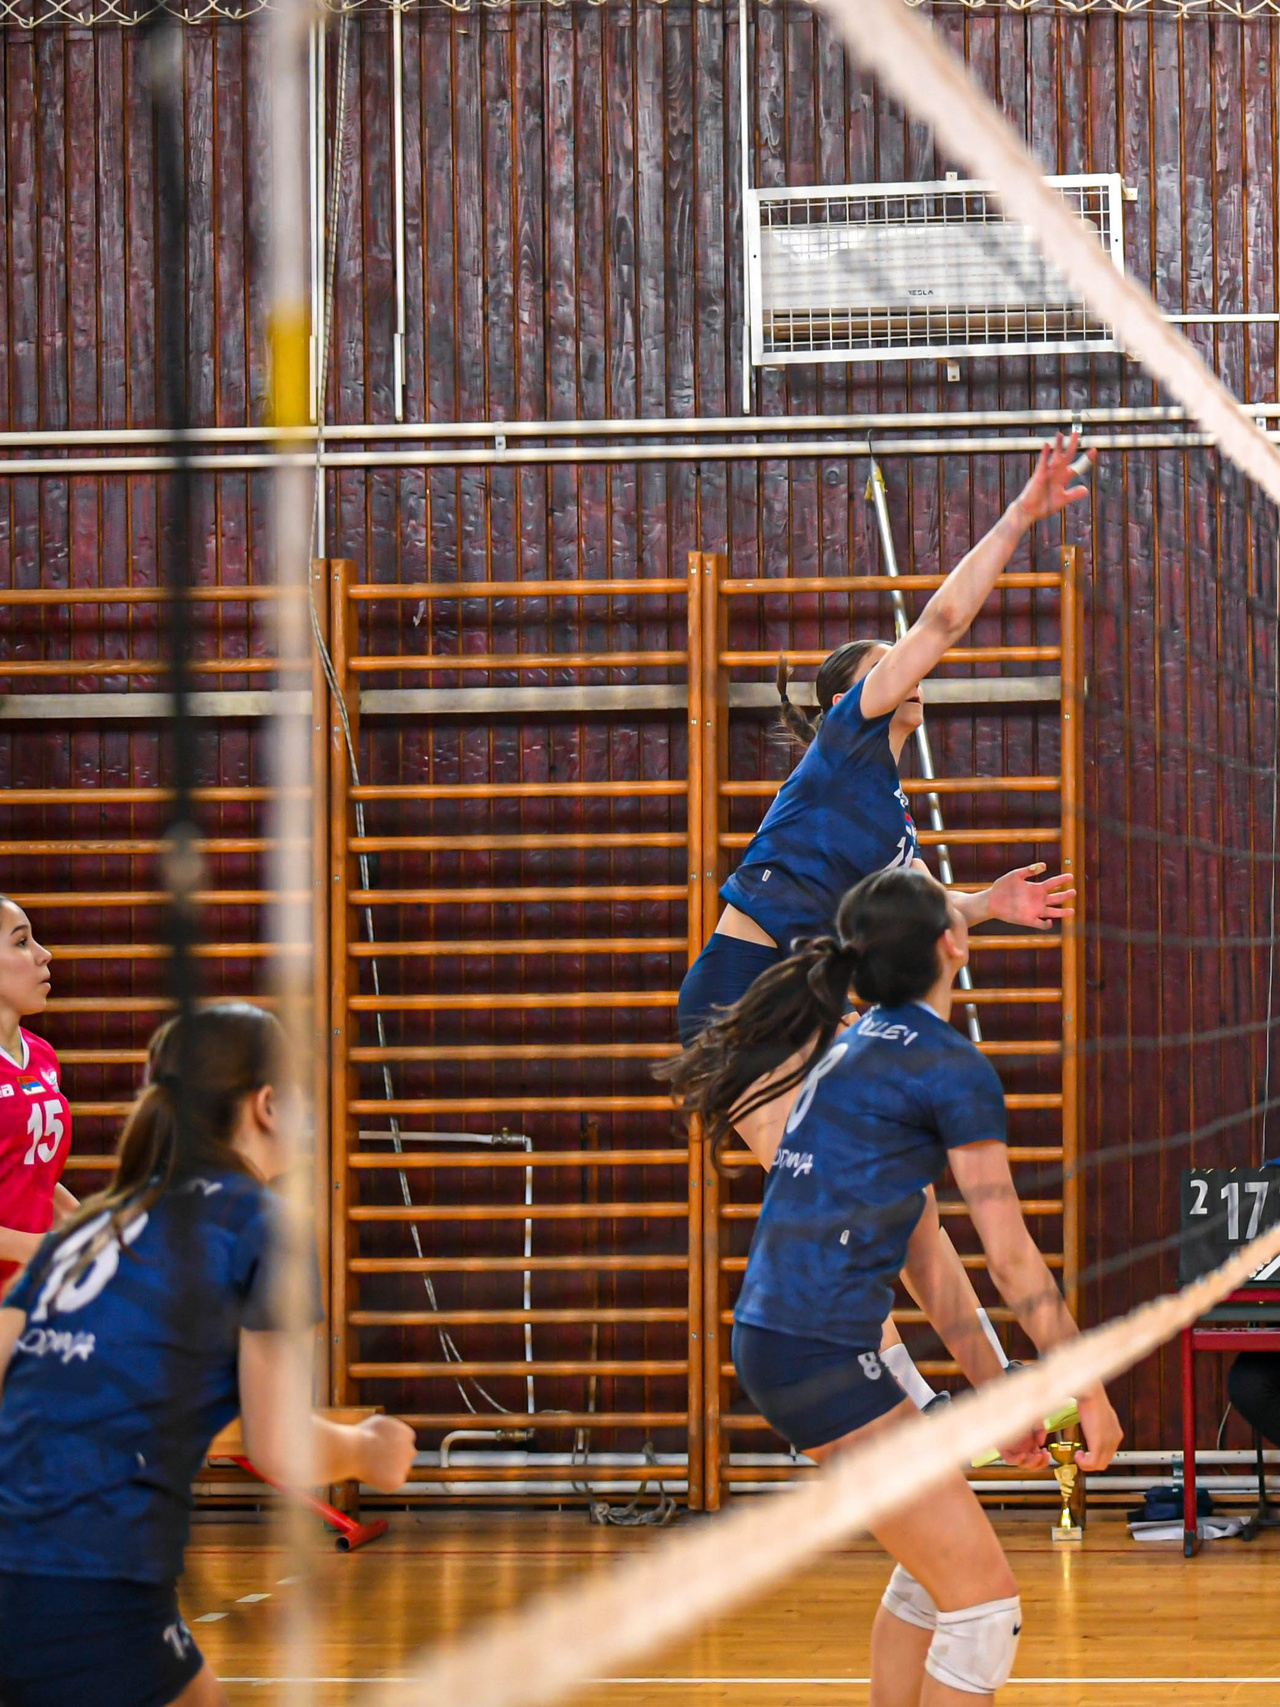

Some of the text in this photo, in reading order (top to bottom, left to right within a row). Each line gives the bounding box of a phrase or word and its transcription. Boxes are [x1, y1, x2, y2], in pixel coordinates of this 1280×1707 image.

[786, 1042, 849, 1134] 8
[23, 1099, 64, 1165] 15
[1189, 1179, 1209, 1215] 2
[1220, 1181, 1269, 1240] 17
[857, 1351, 882, 1381] 8
